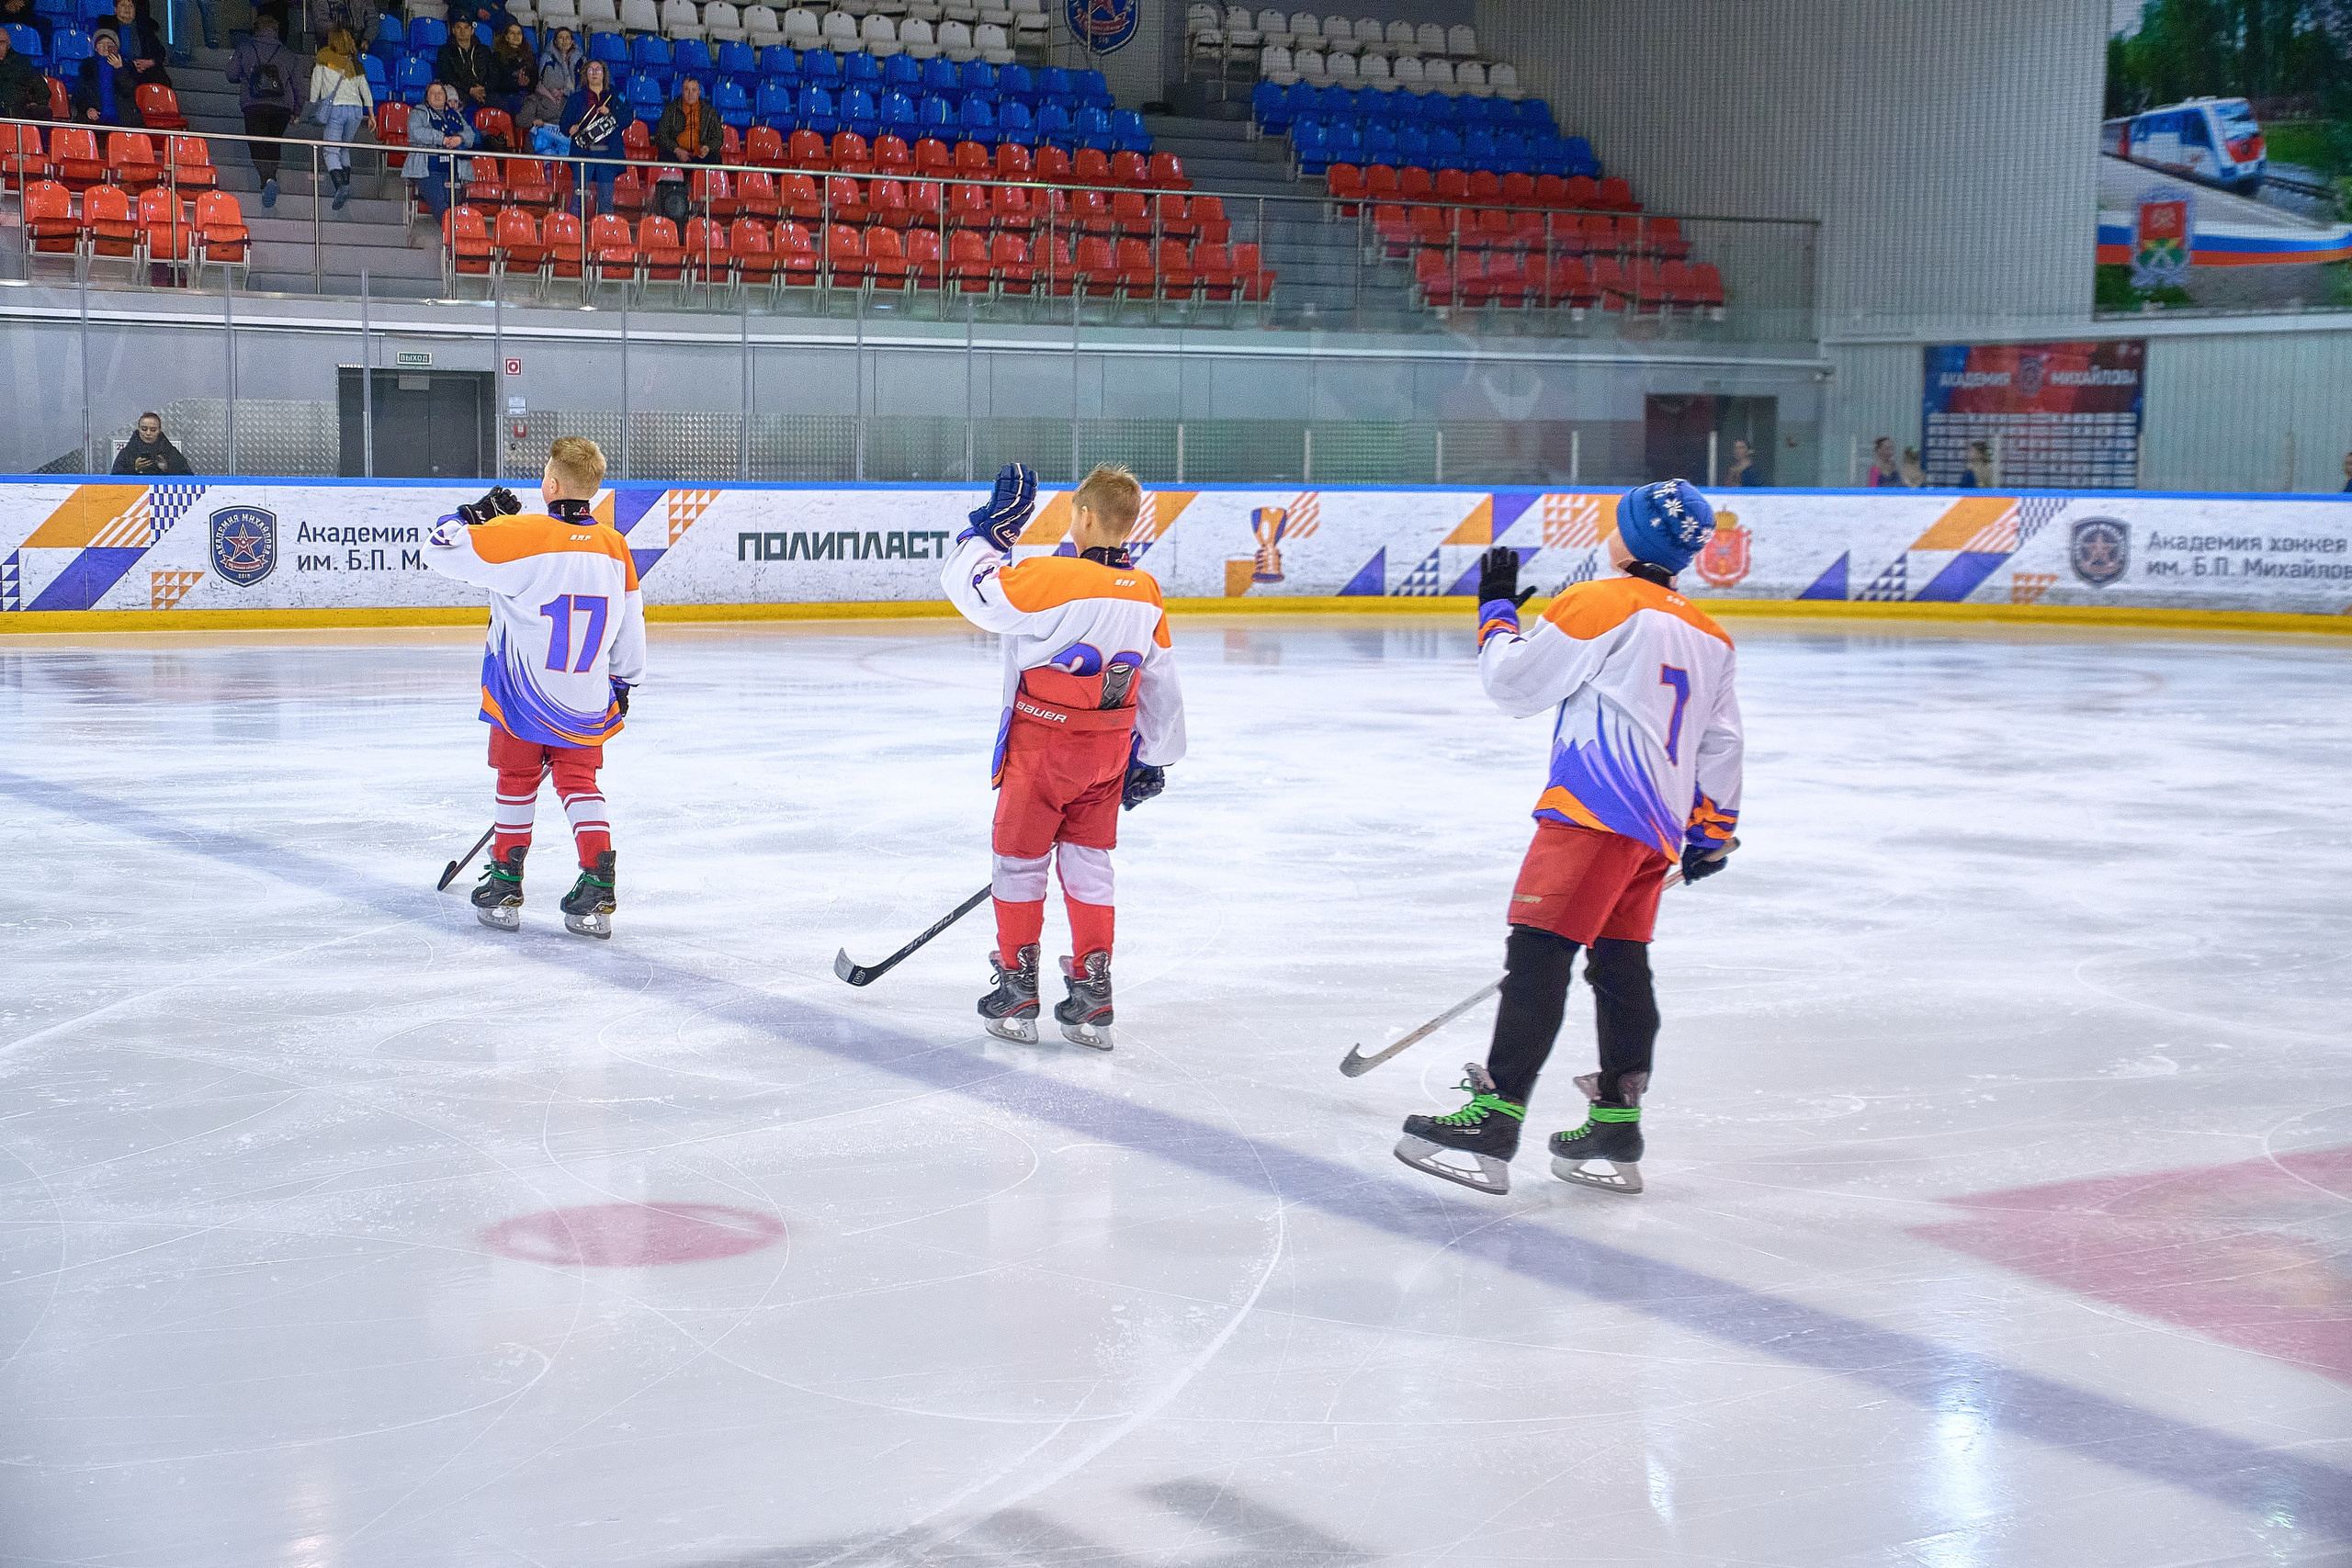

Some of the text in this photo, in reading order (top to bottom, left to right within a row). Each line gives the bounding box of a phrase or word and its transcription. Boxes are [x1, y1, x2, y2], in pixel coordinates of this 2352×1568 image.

[400, 354, 428, 362] ВЫХОД
[296, 521, 419, 546] Академия
[2147, 531, 2347, 553] Академия хоккея
[738, 531, 950, 561] ПОЛИПЛАСТ
[297, 555, 338, 571] им.
[347, 549, 392, 570] Б.П.
[2146, 560, 2186, 576] им.
[540, 593, 608, 673] 17
[1016, 701, 1068, 723] BAUER
[1659, 662, 1690, 767] 7
